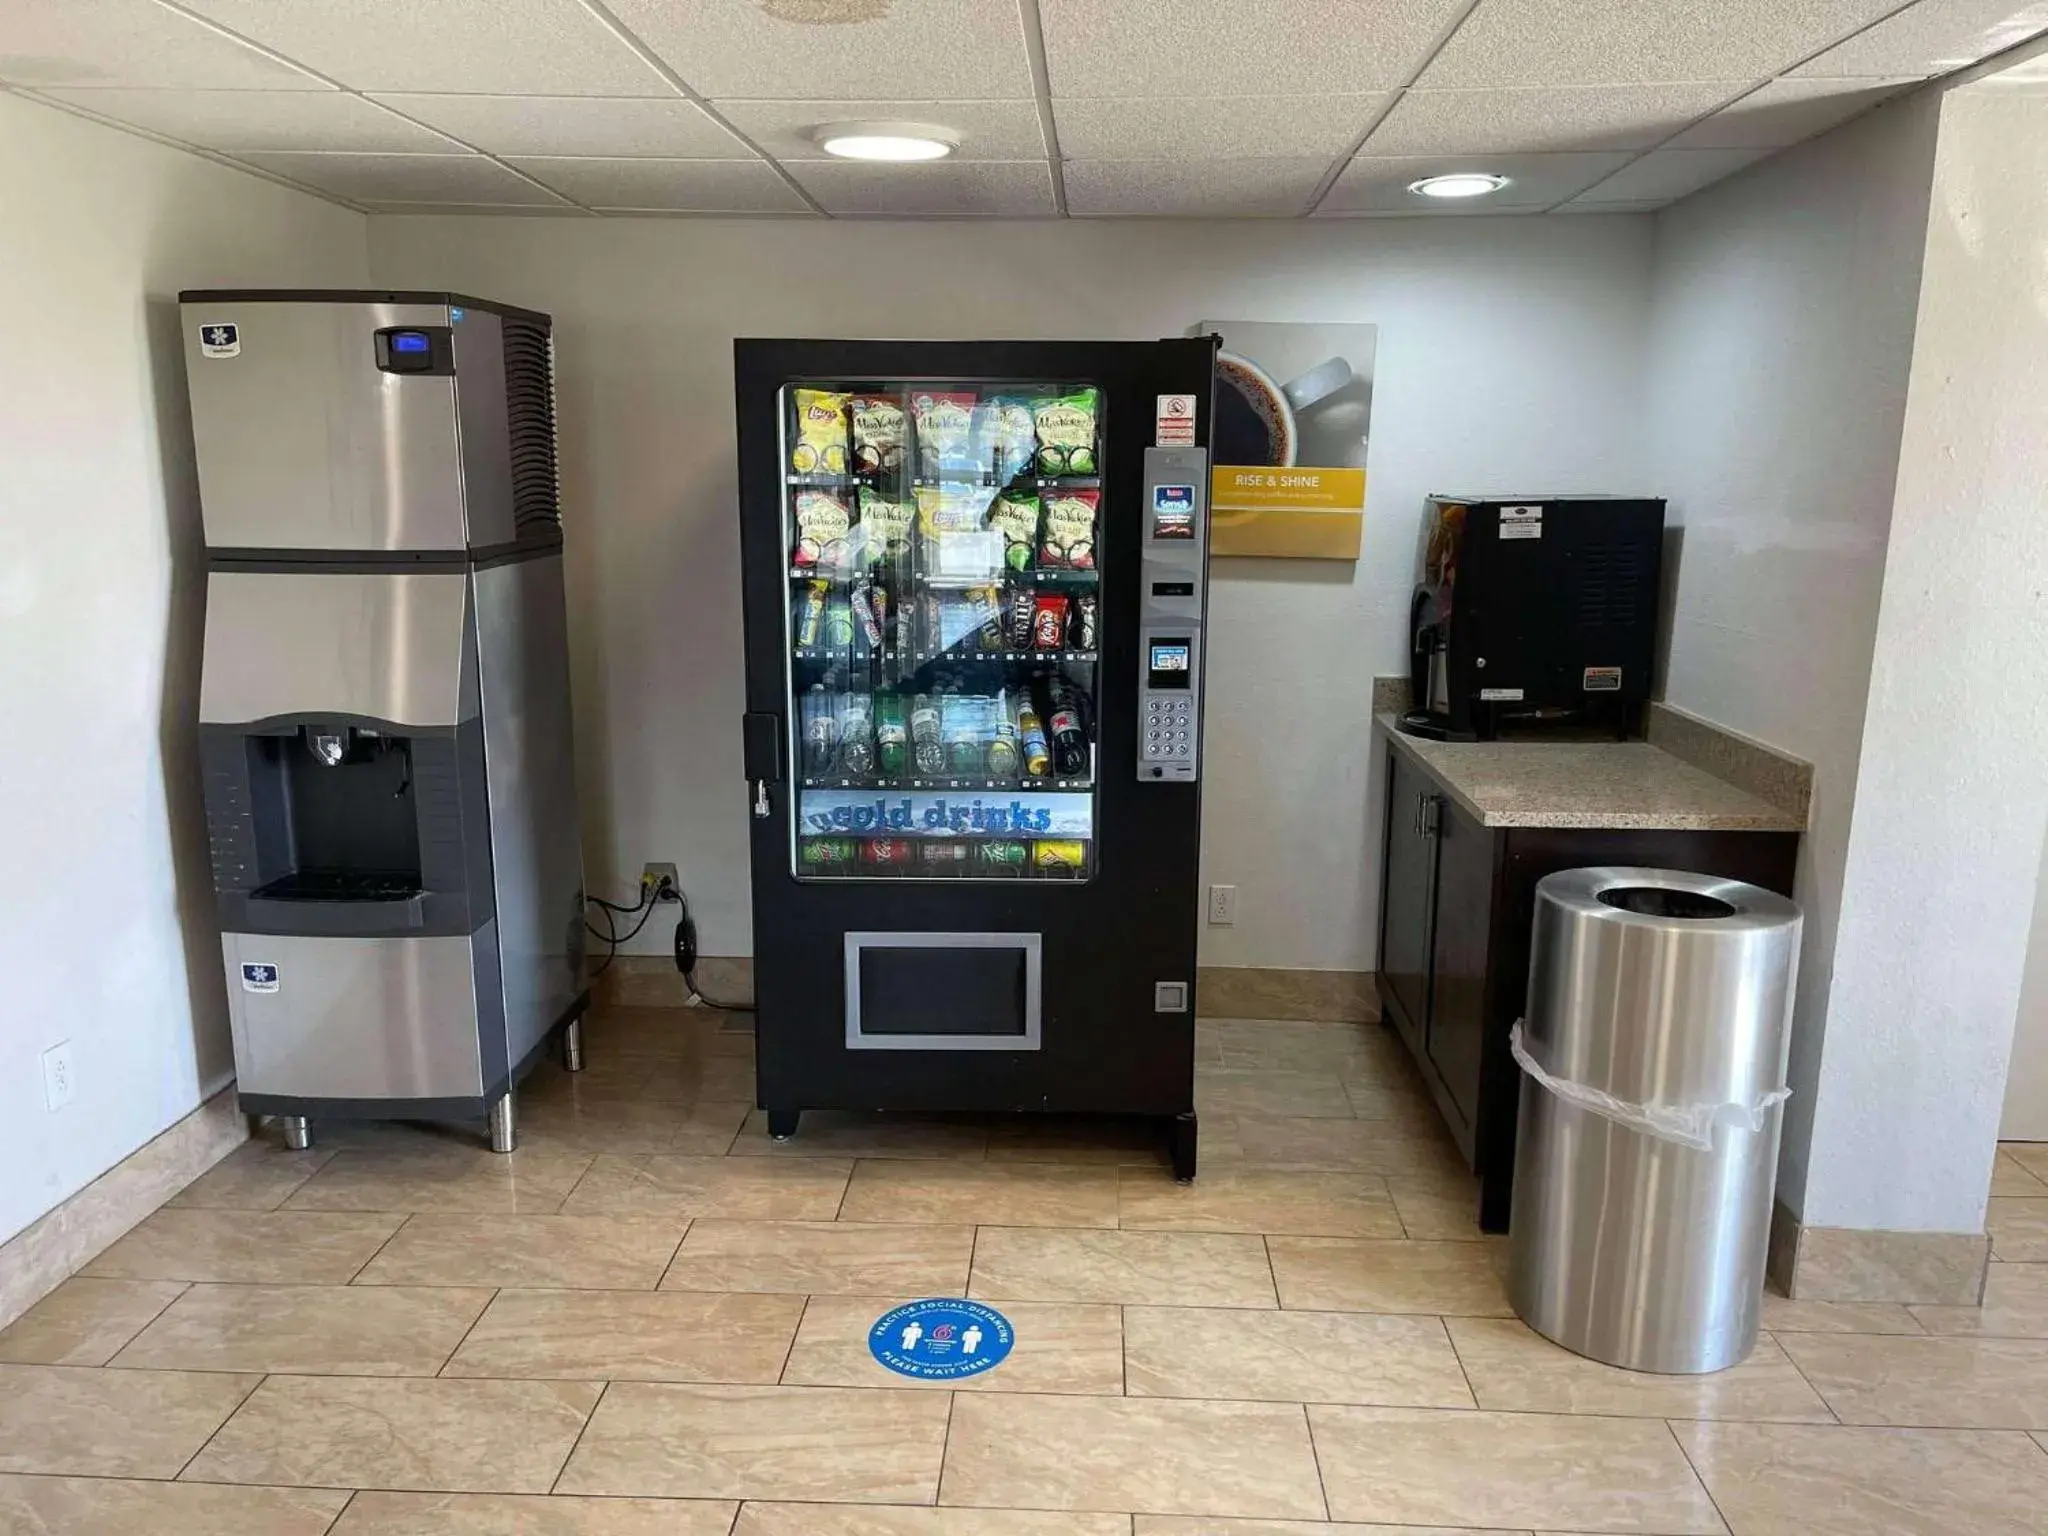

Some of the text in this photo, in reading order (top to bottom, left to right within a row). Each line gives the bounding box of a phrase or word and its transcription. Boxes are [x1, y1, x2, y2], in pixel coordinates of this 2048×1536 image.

[1236, 474, 1320, 487] RISE & SHINE
[923, 798, 1052, 832] drinks
[875, 1306, 917, 1336] PRACTICE
[967, 1306, 1009, 1344] DISTANCING
[881, 1351, 920, 1373] PLEASE
[924, 1367, 955, 1375] WAIT
[960, 1357, 992, 1372] HERE
